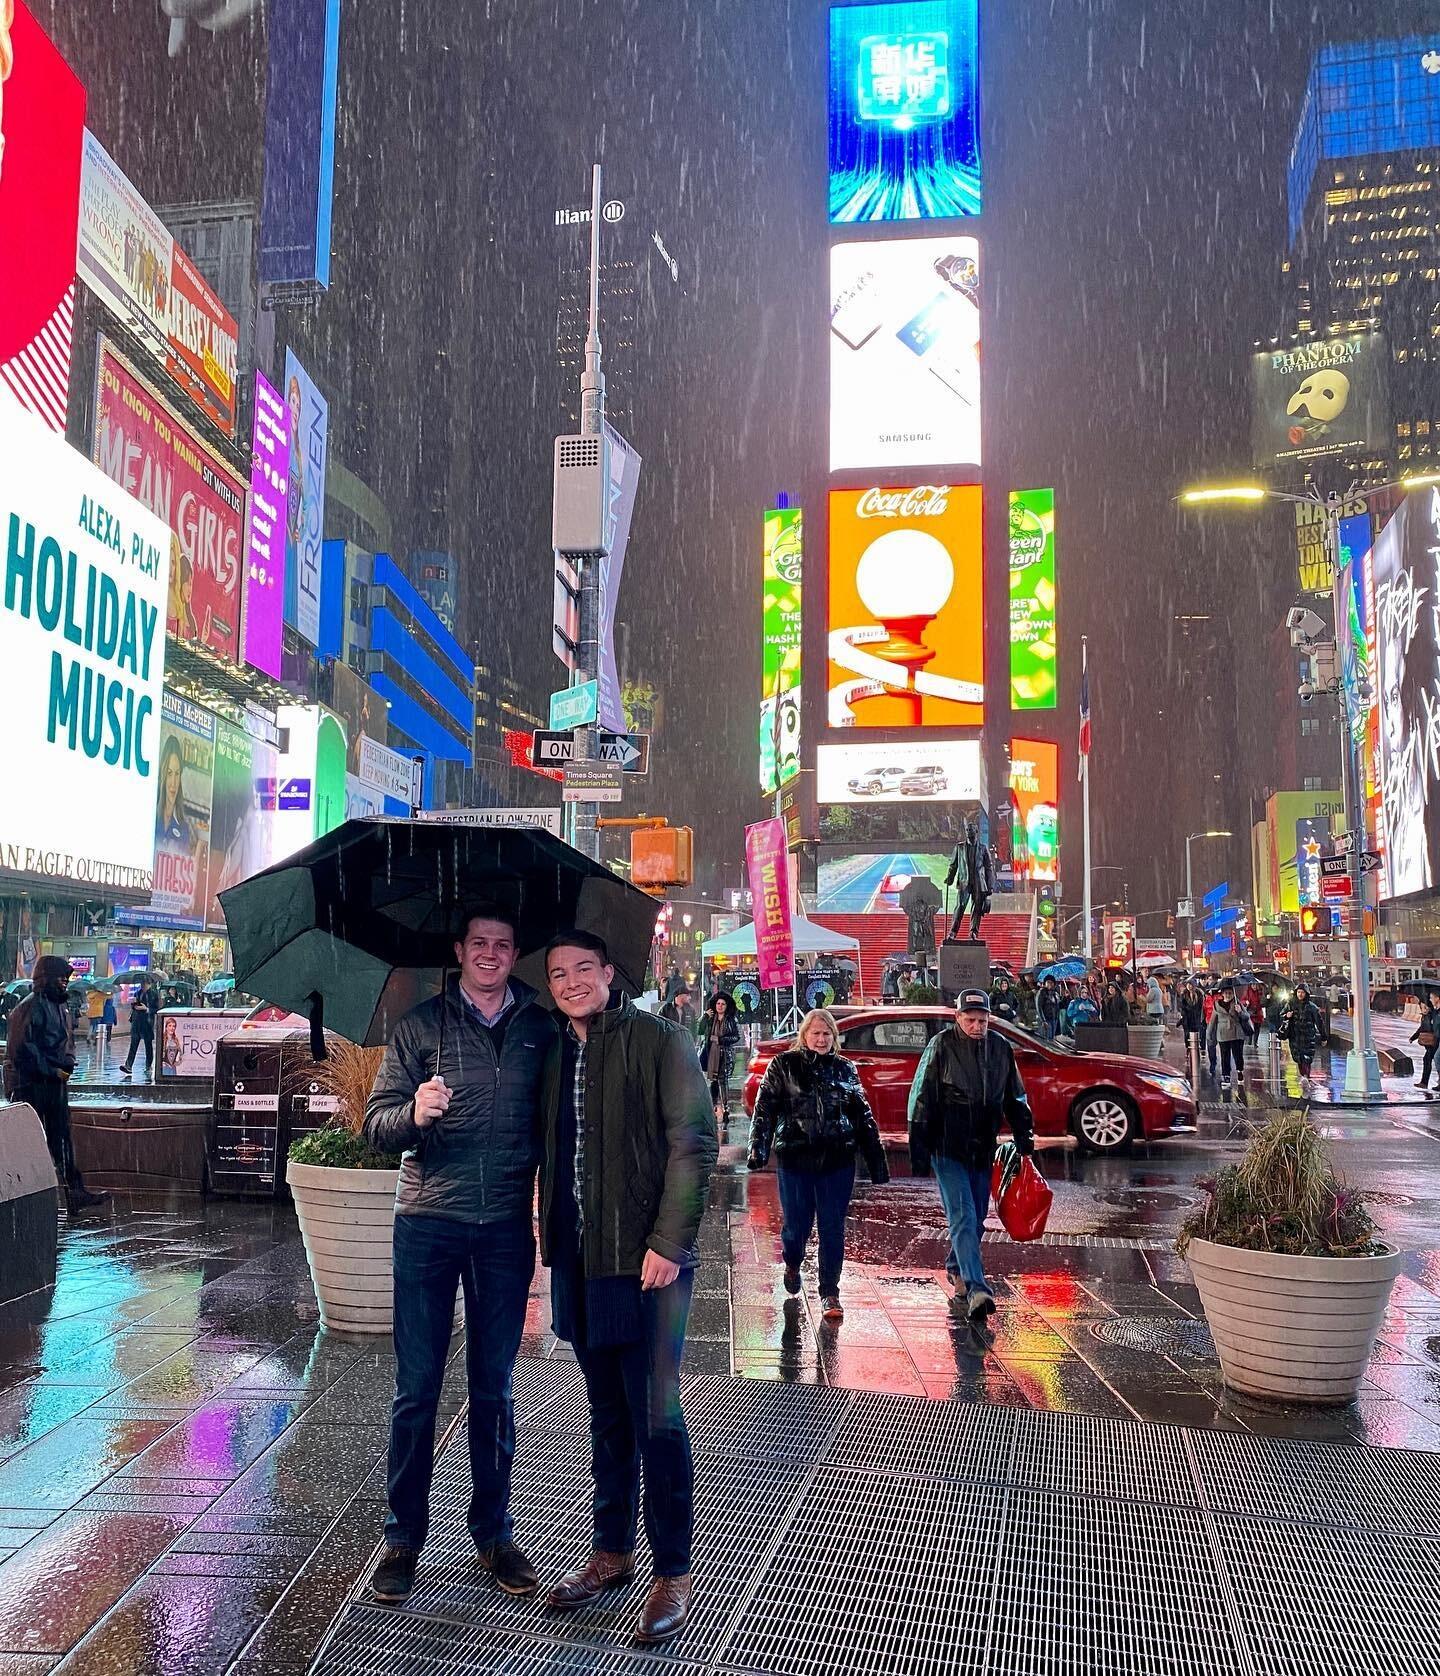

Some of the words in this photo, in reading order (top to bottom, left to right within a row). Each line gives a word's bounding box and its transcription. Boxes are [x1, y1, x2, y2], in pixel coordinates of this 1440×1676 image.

[82, 200, 121, 261] WRONG
[101, 206, 123, 241] GOES
[168, 286, 211, 360] JERSEY
[1271, 341, 1362, 369] PHANTOM
[1304, 340, 1326, 351] THE
[1280, 365, 1295, 375] OF
[1295, 360, 1318, 372] THE
[1318, 354, 1354, 368] OPERA
[122, 385, 152, 424] KNOW
[153, 415, 171, 444] YOU
[173, 434, 203, 475] WANNA
[202, 465, 214, 486] SIT
[213, 475, 232, 504] WITH
[879, 432, 932, 443] SAMSUNG
[101, 414, 171, 530] MEAN
[299, 397, 324, 602] FROZEN
[78, 494, 126, 565] ALEXA,
[131, 532, 161, 581] PLAY
[176, 490, 238, 595] GIRLS
[1298, 543, 1327, 565] TON
[4, 511, 158, 682] HOLIDAY
[766, 634, 794, 645] HASH
[784, 623, 792, 632] A
[47, 650, 153, 777] MUSIC
[183, 702, 212, 730] McPHEE
[363, 743, 390, 769] PEDESTRIAN
[390, 756, 401, 774] FLOW
[400, 760, 411, 779] ZONE
[549, 743, 575, 759] ON
[566, 771, 586, 779] Times
[587, 771, 613, 780] Square
[1017, 776, 1040, 793] YORK
[526, 814, 553, 828] ZONE
[25, 848, 74, 878] EAGLE
[77, 857, 154, 891] OUTFITTERS
[1329, 862, 1347, 870] ONE
[1361, 858, 1373, 867] AY
[760, 861, 784, 926] WISH
[1112, 920, 1131, 957] tkts
[181, 1035, 217, 1059] FRO
